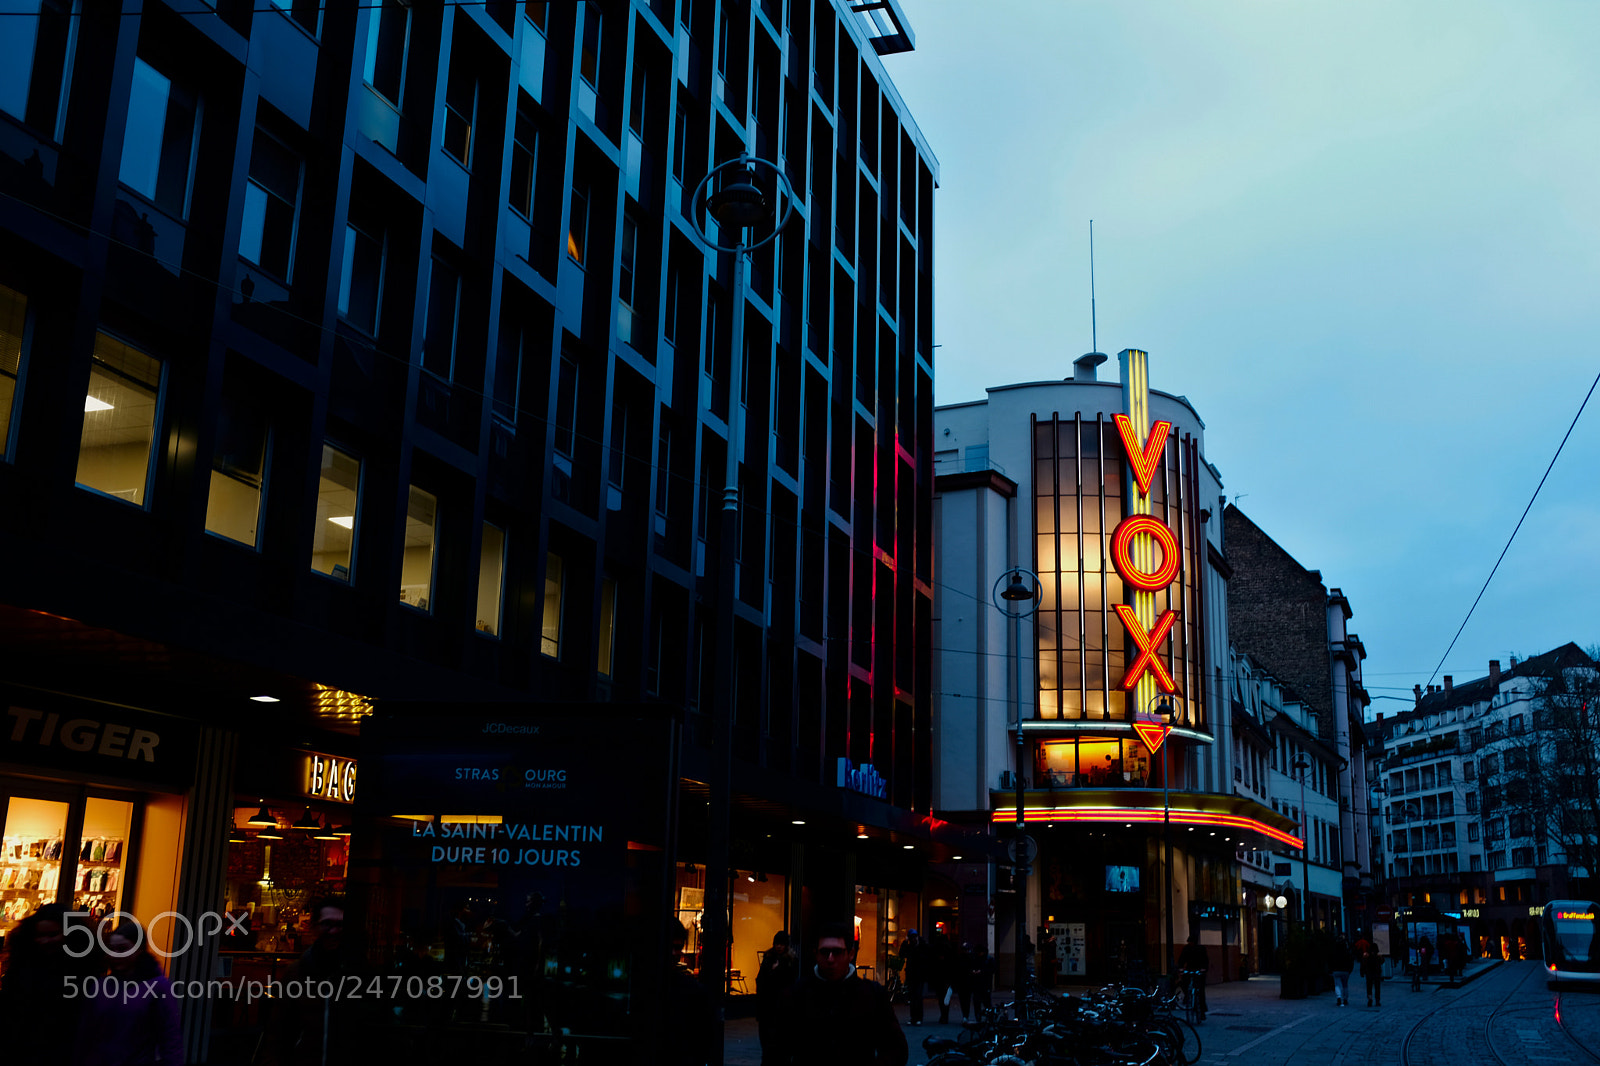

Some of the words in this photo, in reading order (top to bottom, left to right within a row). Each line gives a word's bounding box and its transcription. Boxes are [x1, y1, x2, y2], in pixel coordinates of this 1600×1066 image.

[1109, 412, 1182, 696] VOX
[7, 705, 160, 763] TIGER
[482, 722, 540, 735] JCDecaux
[412, 821, 436, 838] LA
[440, 821, 604, 843] SAINT-VALENTIN
[431, 845, 487, 865] DURE
[490, 848, 511, 865] 10
[514, 848, 582, 867] JOURS
